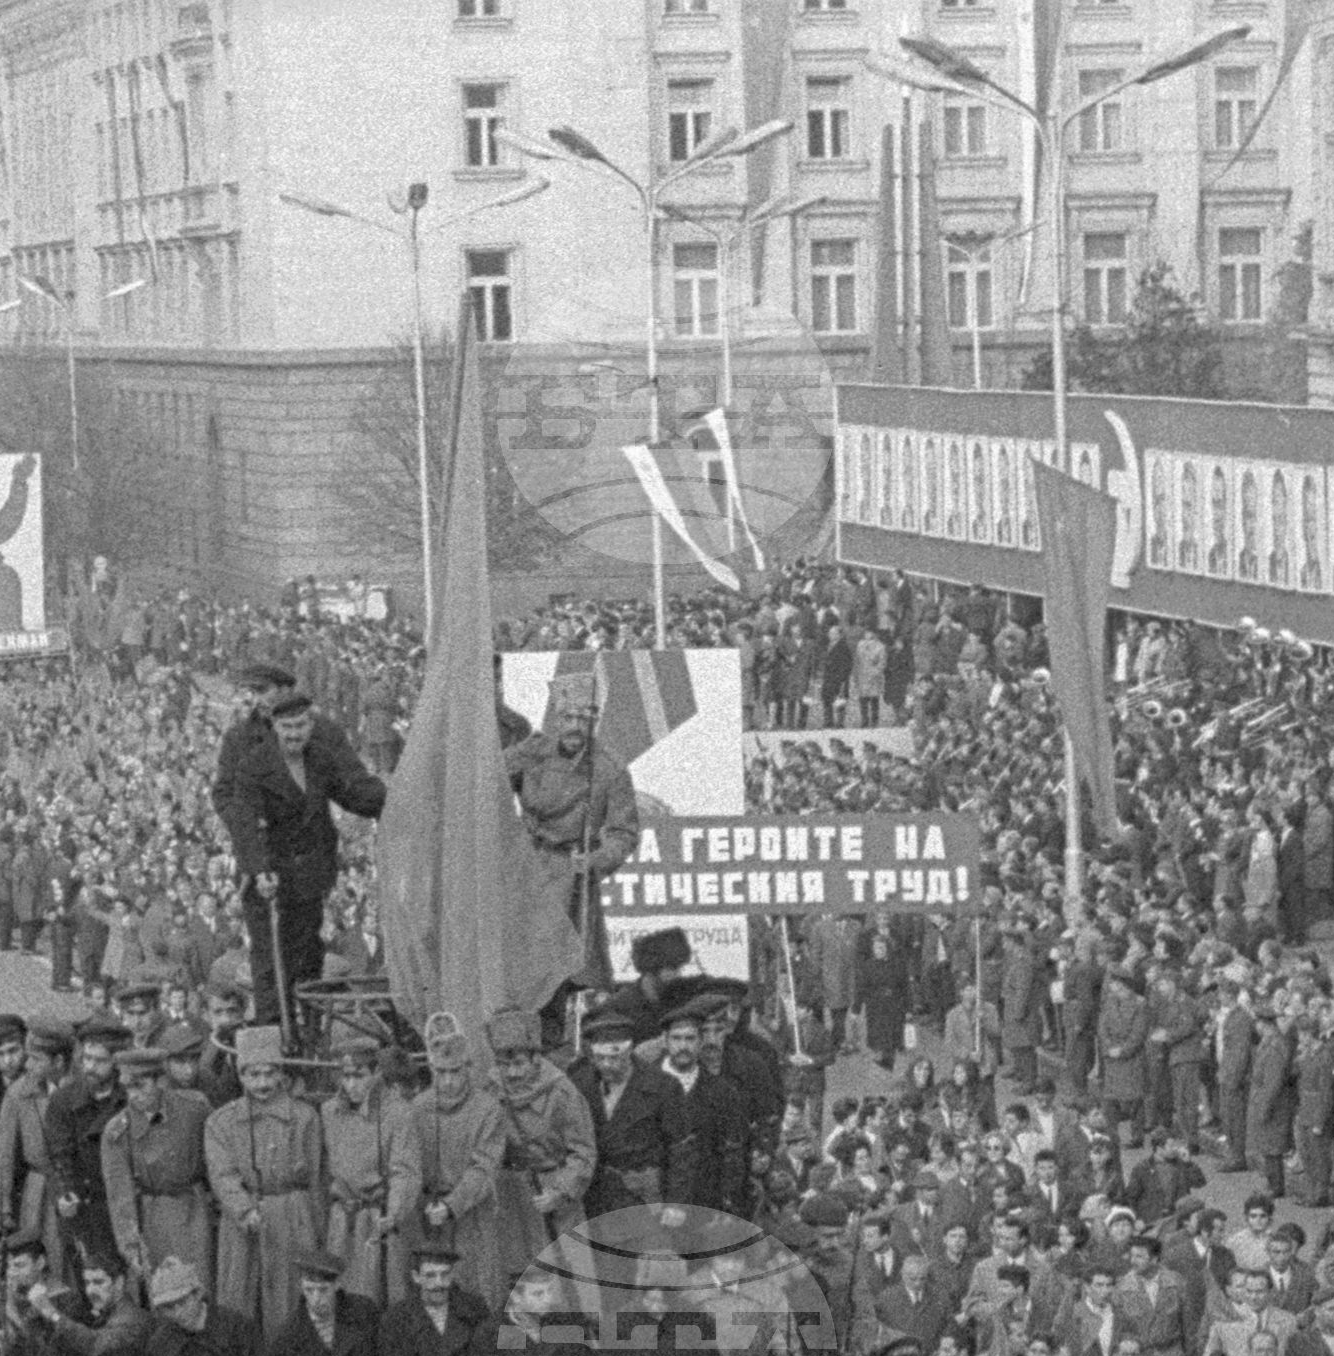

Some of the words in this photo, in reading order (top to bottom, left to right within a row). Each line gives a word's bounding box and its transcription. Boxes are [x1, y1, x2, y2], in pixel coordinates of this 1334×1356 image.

[625, 828, 662, 863] А
[681, 826, 864, 863] ГЕРОИТЕ
[894, 824, 946, 861] НА
[847, 865, 969, 904] ТРУД!
